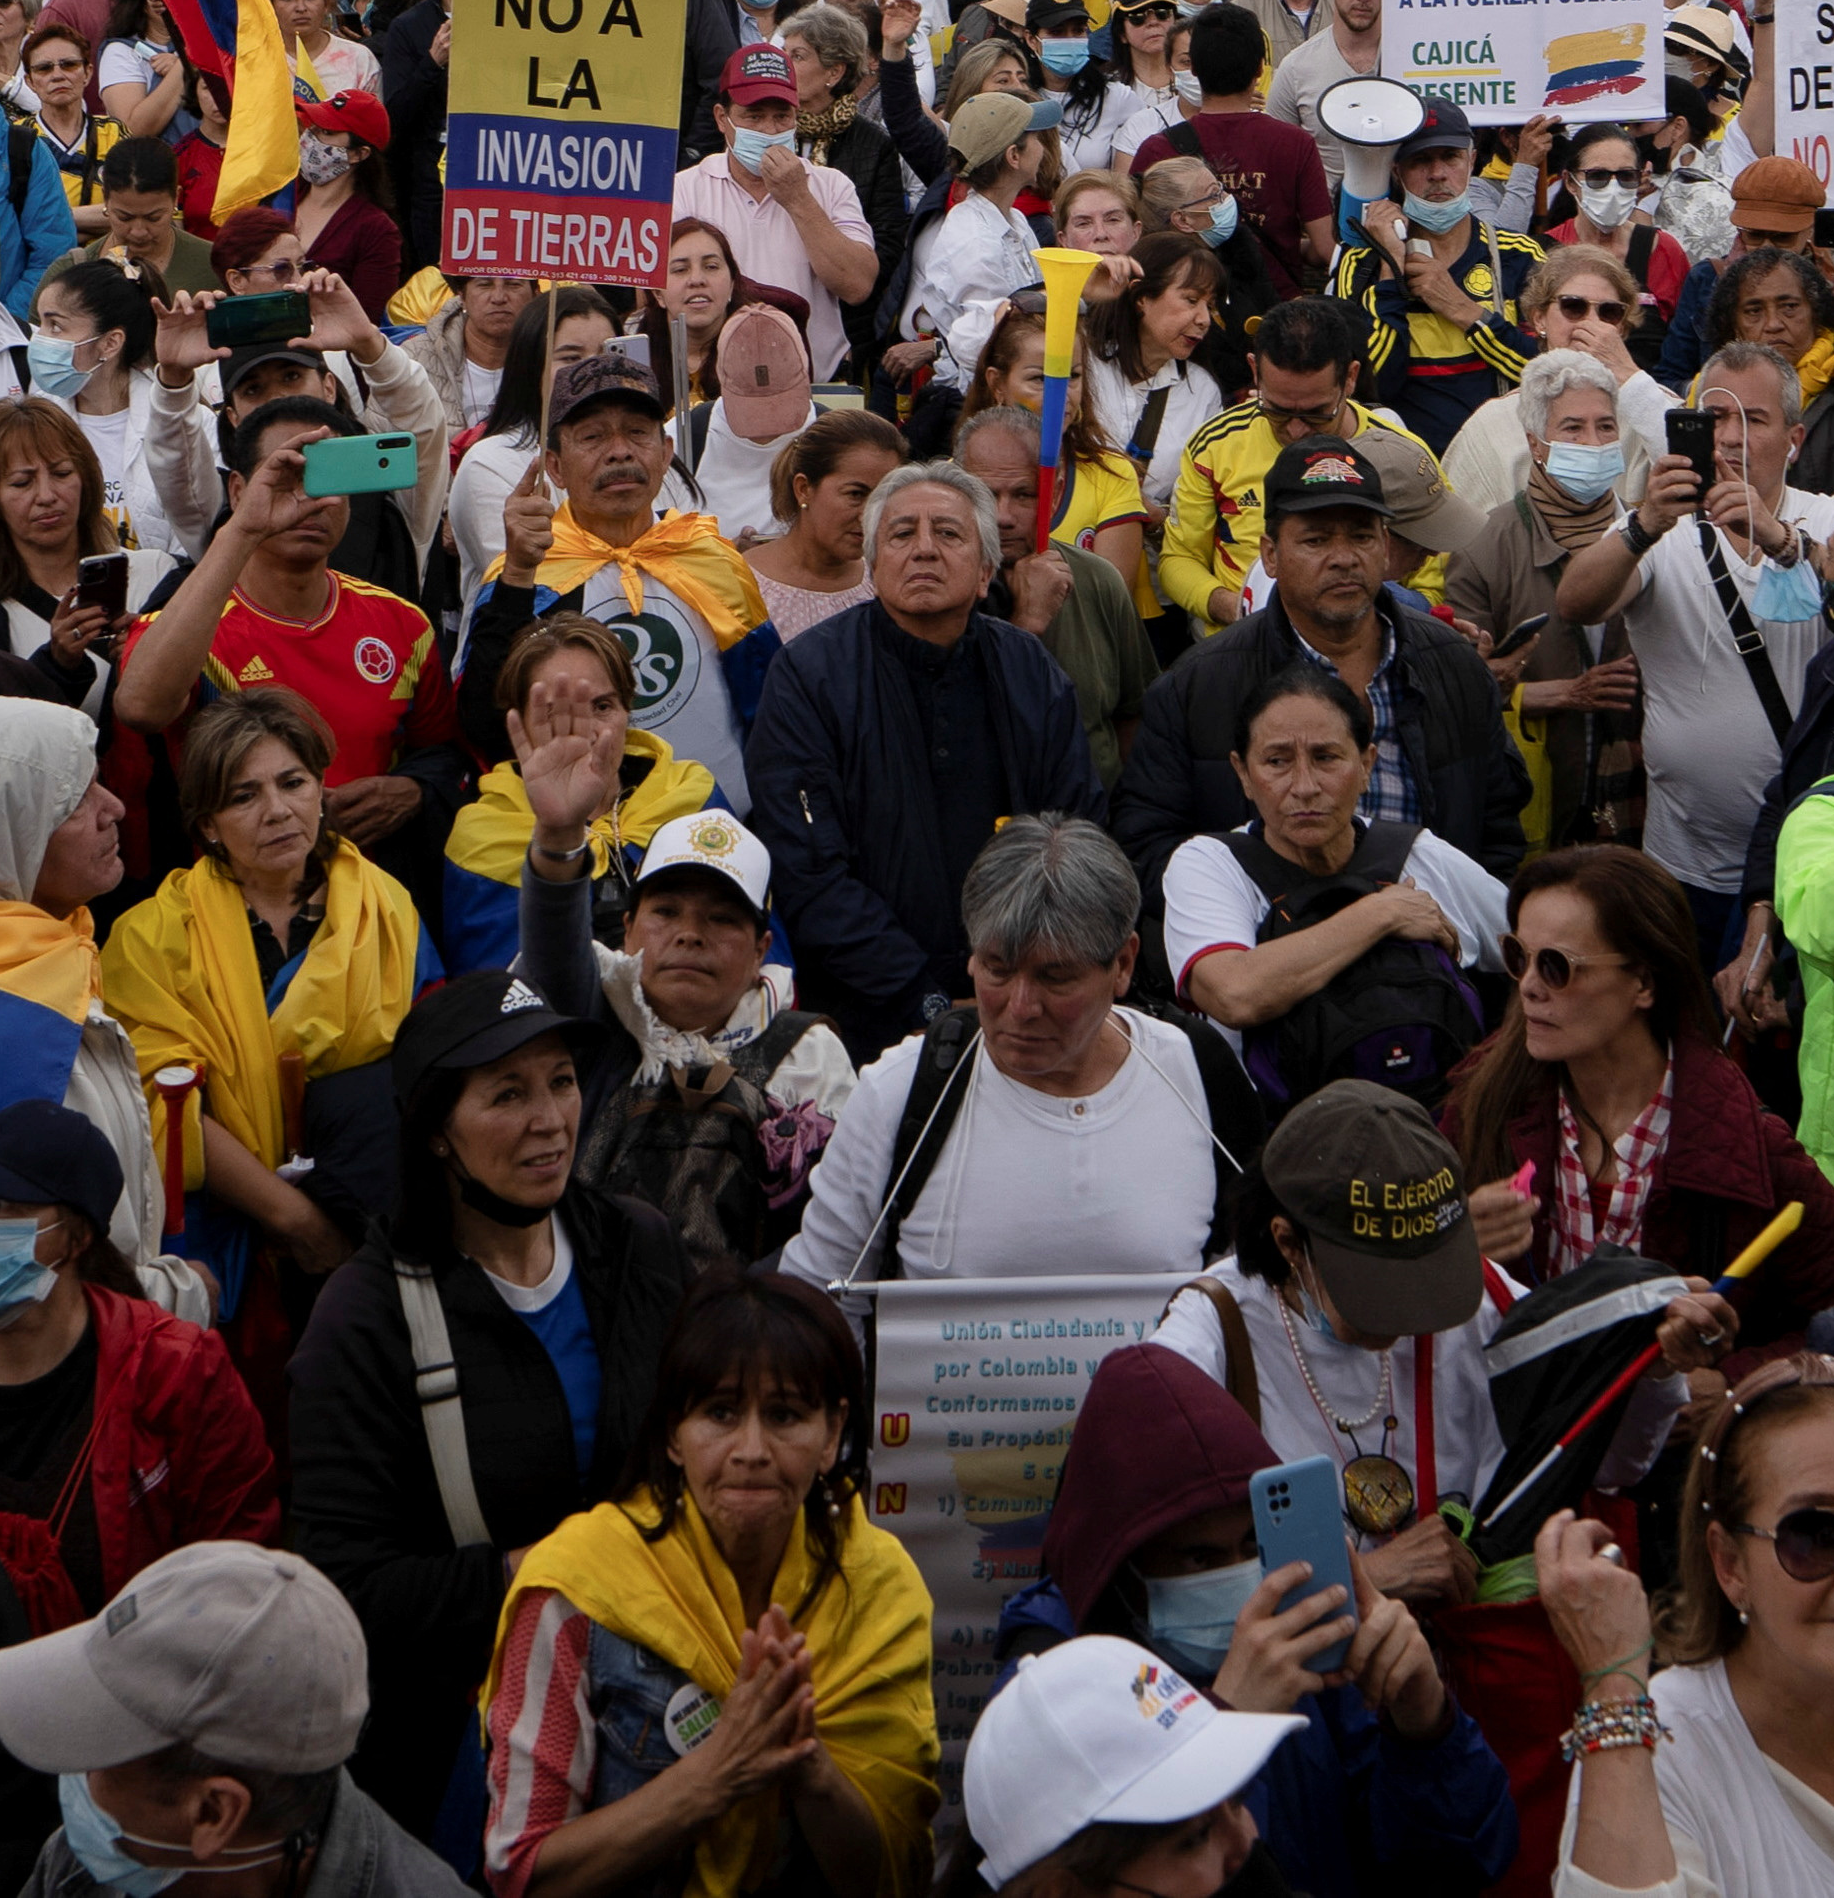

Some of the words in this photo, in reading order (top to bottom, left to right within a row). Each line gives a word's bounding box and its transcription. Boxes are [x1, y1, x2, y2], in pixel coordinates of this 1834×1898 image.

[1411, 33, 1496, 66] CAJICÁ
[527, 55, 602, 111] LA
[1406, 81, 1516, 106] ESENTE
[476, 128, 644, 192] INVASION
[1792, 134, 1831, 190] NO
[450, 207, 499, 261] DE
[509, 209, 660, 273] TIERRAS
[458, 265, 486, 275] FAVOR
[485, 267, 539, 277] DEVOLVERLO
[540, 270, 550, 278] AL
[1237, 500, 1262, 508] adidas
[239, 671, 275, 683] adidas
[500, 995, 545, 1014] adidas
[1349, 1179, 1376, 1211] EL
[1381, 1166, 1455, 1211] EJÉRCITO
[1352, 1211, 1383, 1238] DE
[1390, 1210, 1437, 1240] DIOS
[940, 1319, 1002, 1341] Unión
[1009, 1317, 1126, 1339] Ciudadanía
[1131, 1321, 1146, 1340] y
[933, 1361, 972, 1383] por
[977, 1356, 1077, 1377] Colombia
[1084, 1362, 1099, 1381] y
[925, 1394, 1077, 1412] Conformemos
[880, 1413, 910, 1448] U
[875, 1472, 909, 1505] N
[936, 1495, 956, 1516] 1)
[971, 1560, 995, 1581] 2)
